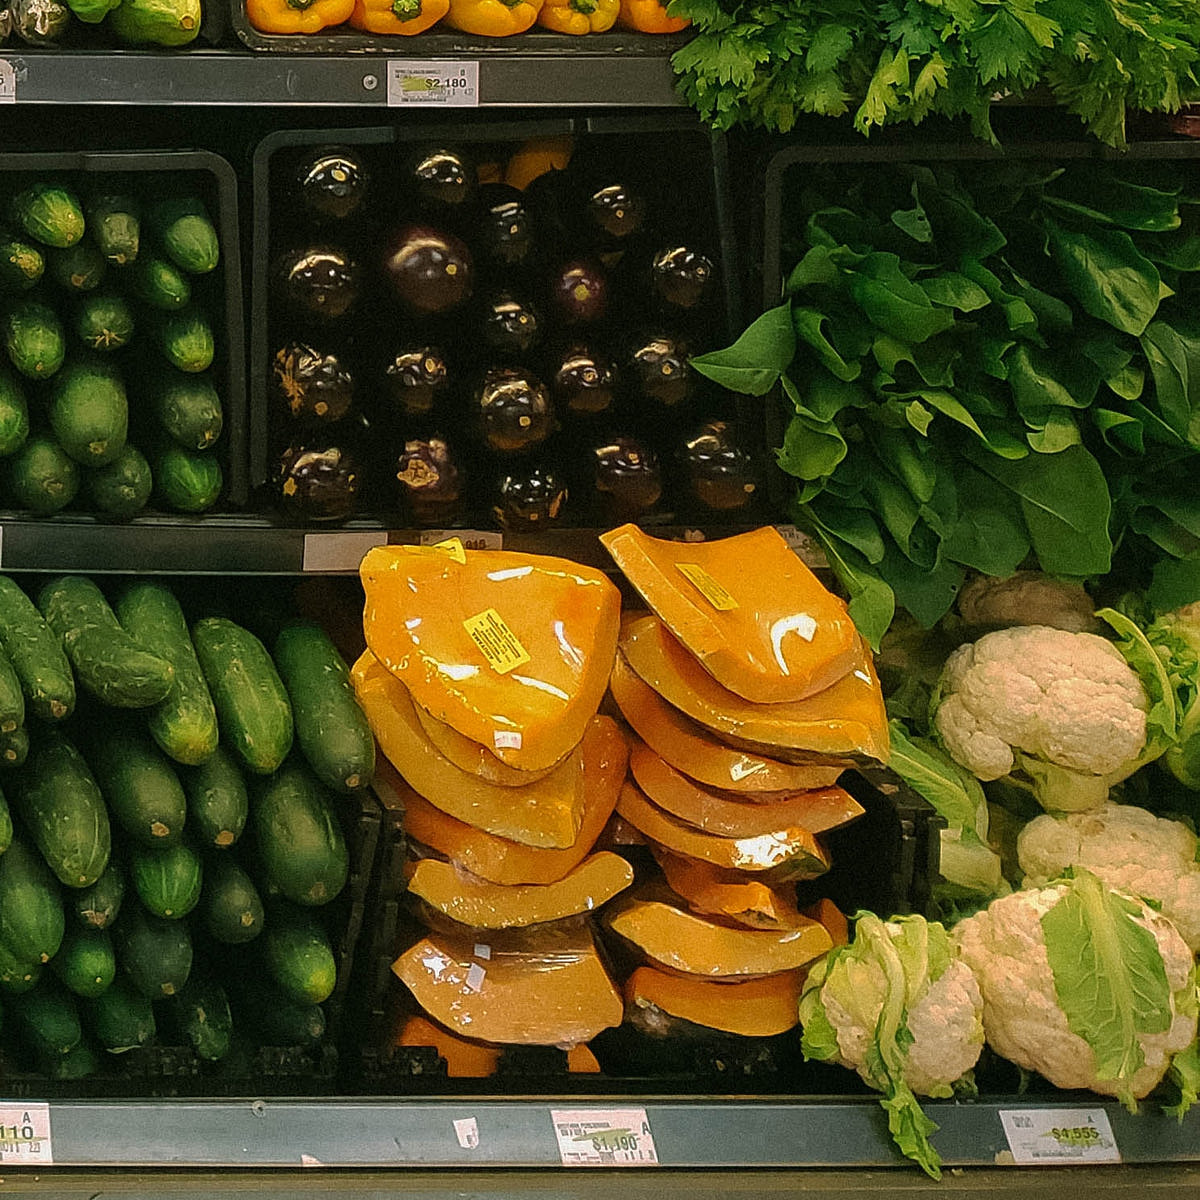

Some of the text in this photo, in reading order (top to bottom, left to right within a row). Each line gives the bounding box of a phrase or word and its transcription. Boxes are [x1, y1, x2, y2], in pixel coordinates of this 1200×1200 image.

[425, 78, 467, 89] $2,180
[22, 1111, 31, 1123] A
[641, 1121, 650, 1135] A
[1051, 1127, 1100, 1140] $4,555
[592, 1136, 638, 1151] $1,190
